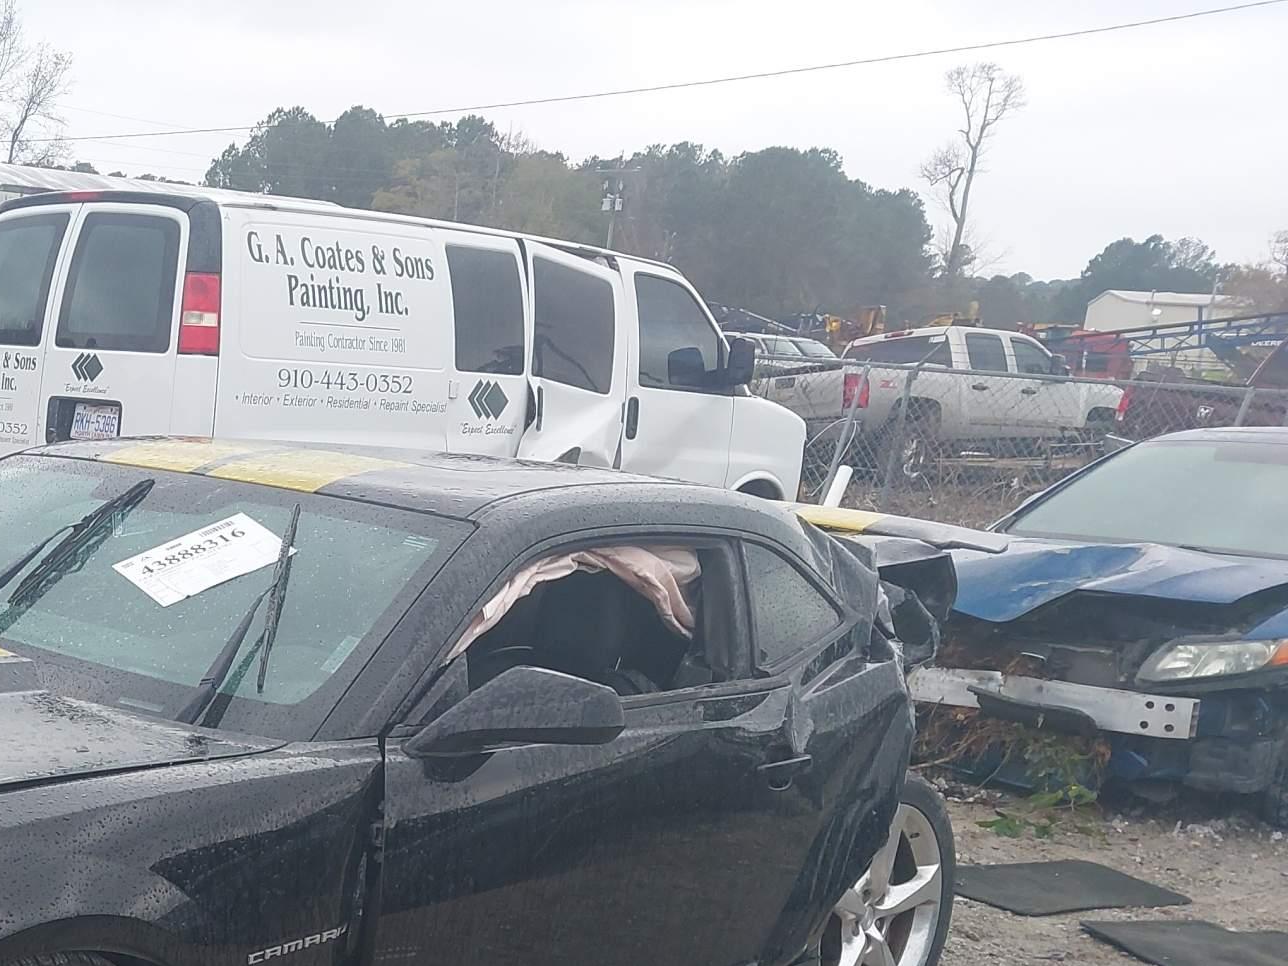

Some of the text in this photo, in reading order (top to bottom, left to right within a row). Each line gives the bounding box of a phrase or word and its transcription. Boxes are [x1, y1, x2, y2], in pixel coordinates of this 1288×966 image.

[247, 230, 434, 281] G. A. Coates & Sons
[287, 273, 409, 322] Painting, Inc.
[295, 331, 406, 353] Painting Contractor Since 1981
[3, 352, 12, 369] &
[13, 352, 37, 371] Sons
[1, 372, 17, 391] Inc.
[277, 368, 414, 395] 910-443-0352
[242, 393, 447, 415] Interior Exterior Residential Repaint Specialist
[140, 527, 246, 576] 43888316
